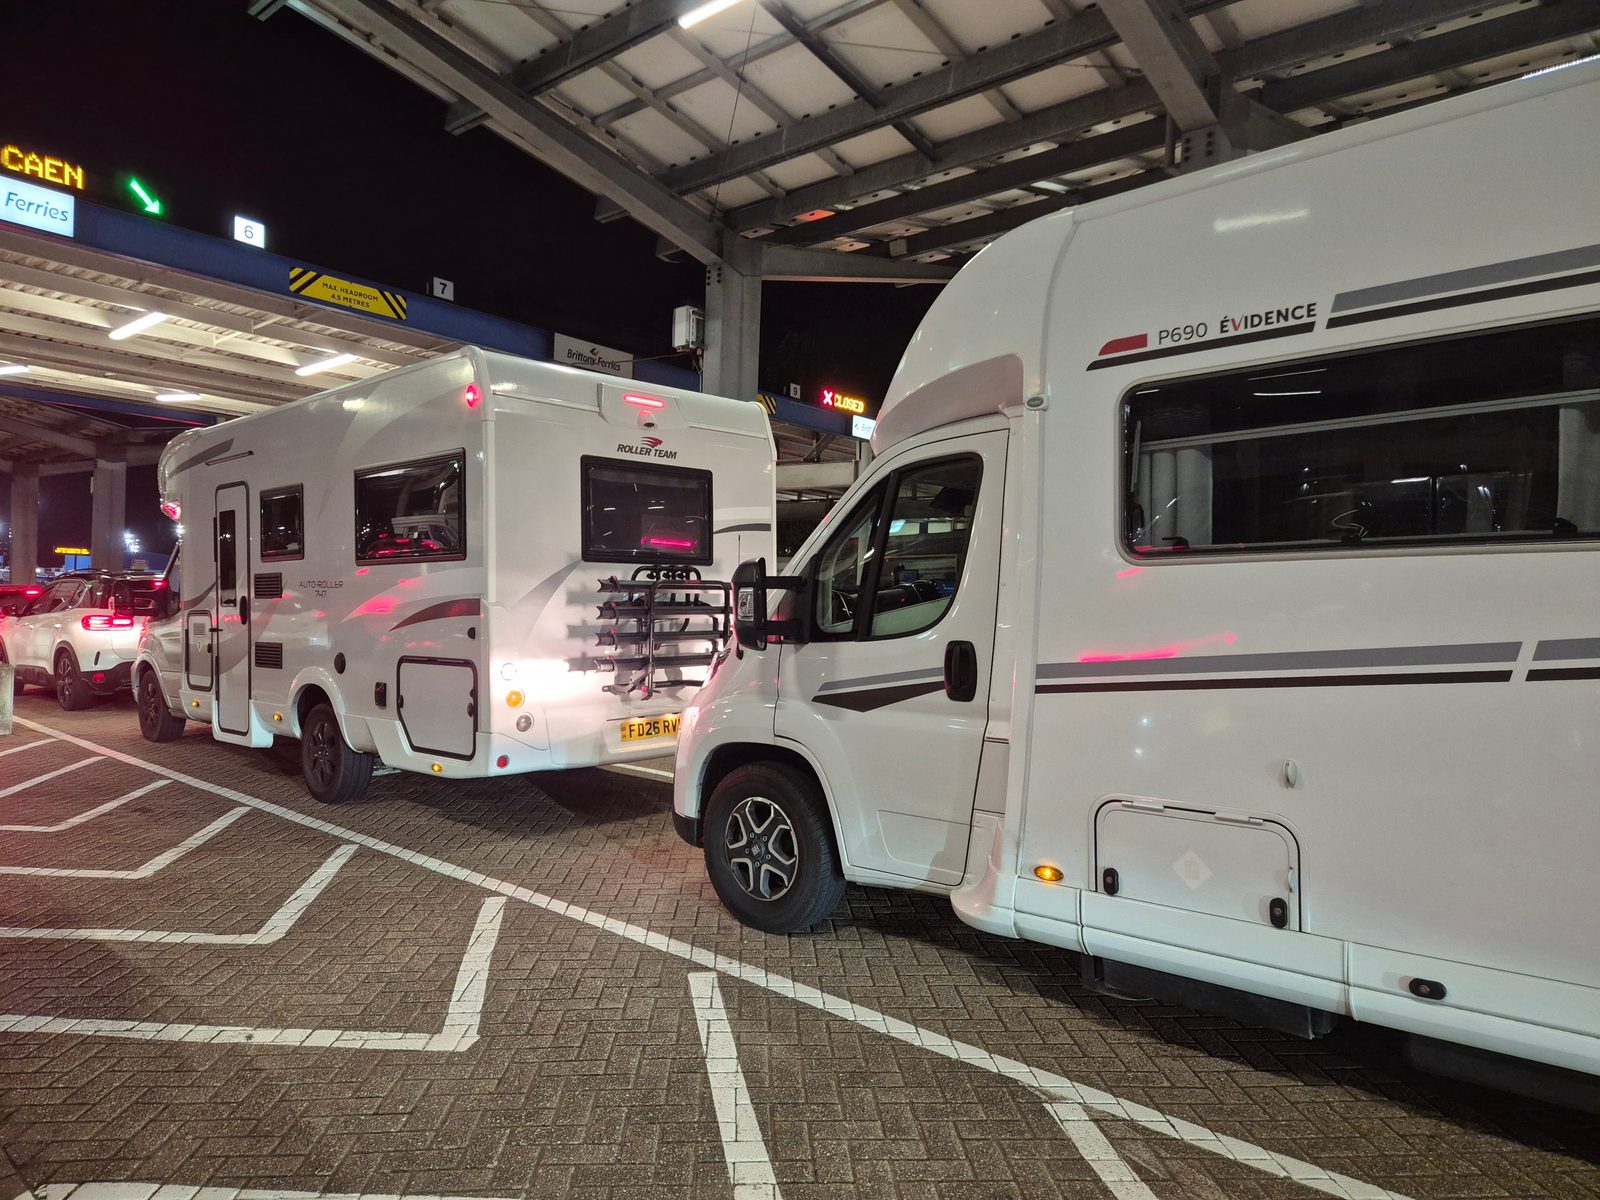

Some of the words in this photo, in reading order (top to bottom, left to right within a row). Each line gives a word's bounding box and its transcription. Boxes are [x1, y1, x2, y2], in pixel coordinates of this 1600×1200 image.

[1, 145, 84, 190] CAEN
[5, 191, 69, 222] Ferries
[244, 225, 254, 239] 6
[340, 287, 379, 302] HEADROOM
[439, 282, 448, 295] 7
[343, 296, 370, 308] METRES
[1158, 322, 1208, 345] P690
[1220, 302, 1318, 334] ÉVIDENCE
[566, 348, 597, 366] Brittany
[597, 357, 621, 372] Ferries
[793, 386, 798, 396] 9
[834, 394, 865, 413] CLOSED
[616, 443, 652, 457] ROLLER
[653, 448, 678, 460] TEAM
[299, 580, 344, 589] AUTO-ROLLER
[628, 720, 660, 738] FD26
